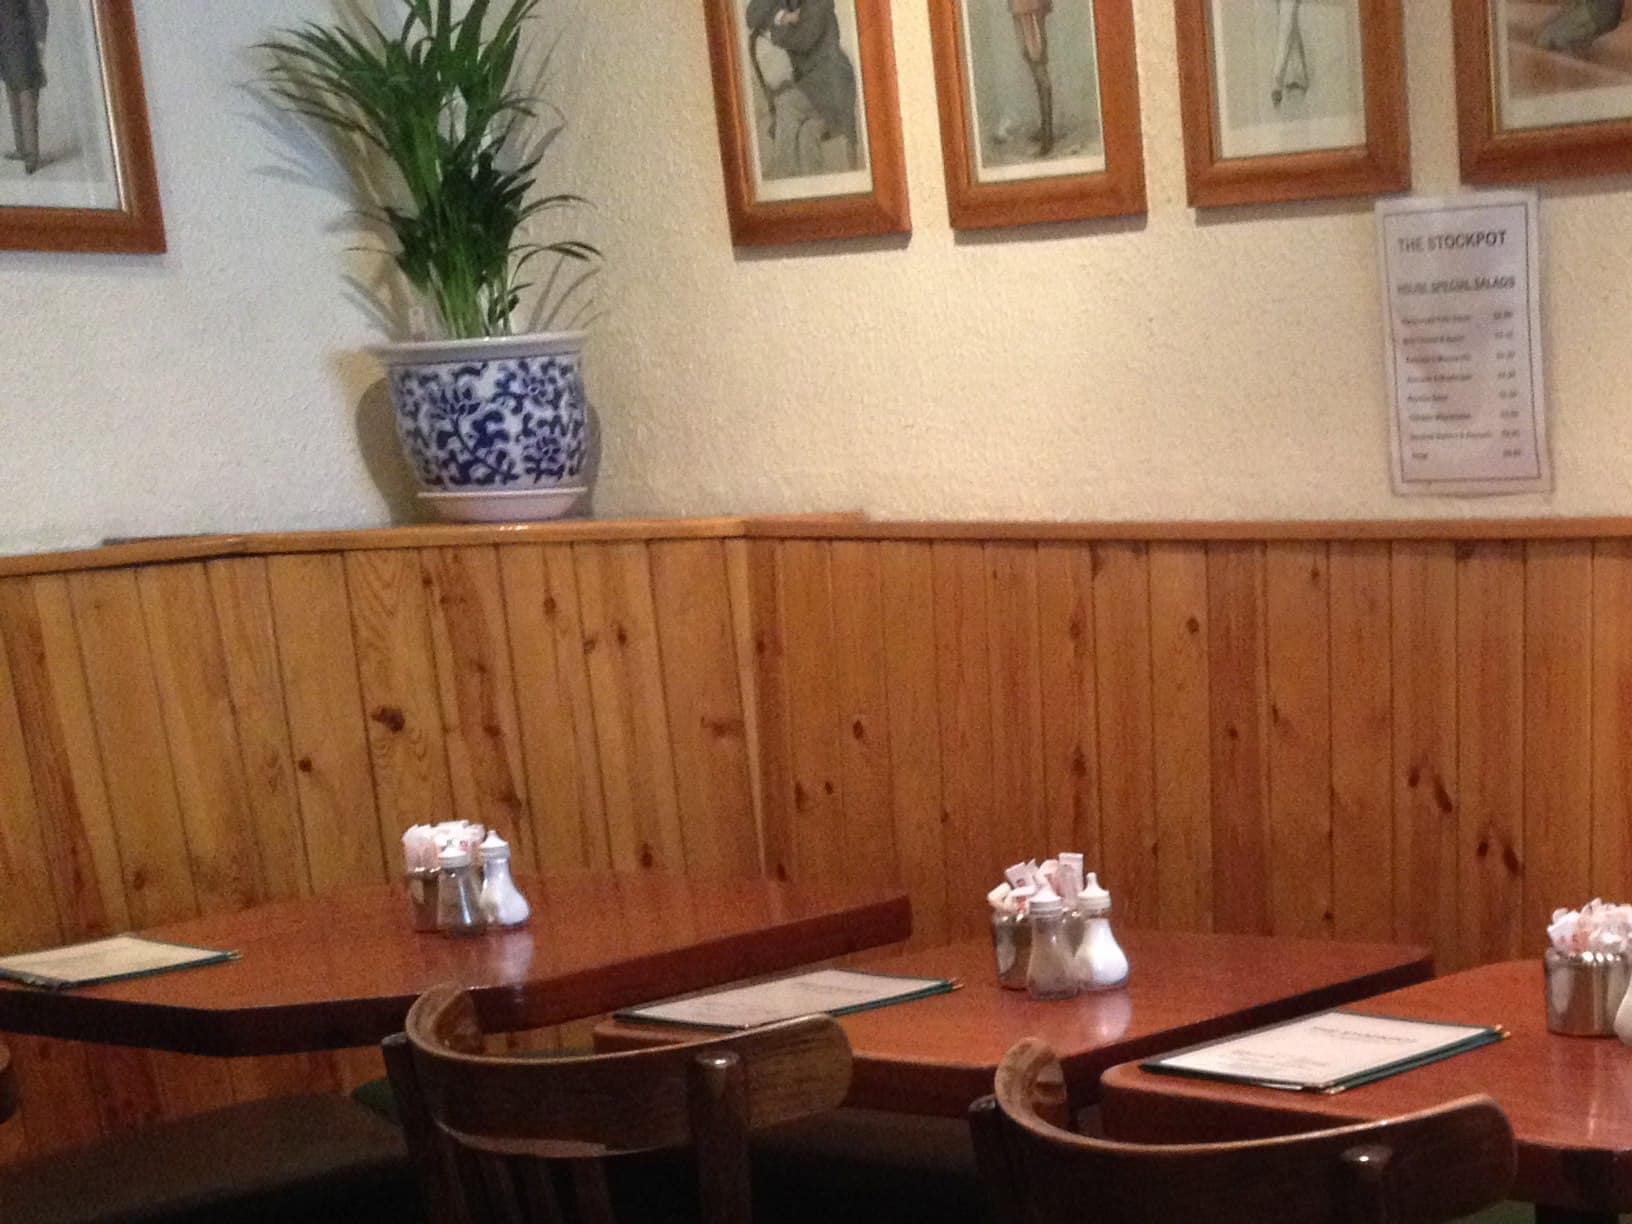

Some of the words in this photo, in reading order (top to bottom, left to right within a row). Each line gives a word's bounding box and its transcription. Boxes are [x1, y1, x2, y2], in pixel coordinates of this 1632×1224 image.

[1399, 237, 1423, 252] THE
[1427, 231, 1507, 249] STOCKPOT
[1474, 276, 1516, 291] SALADS
